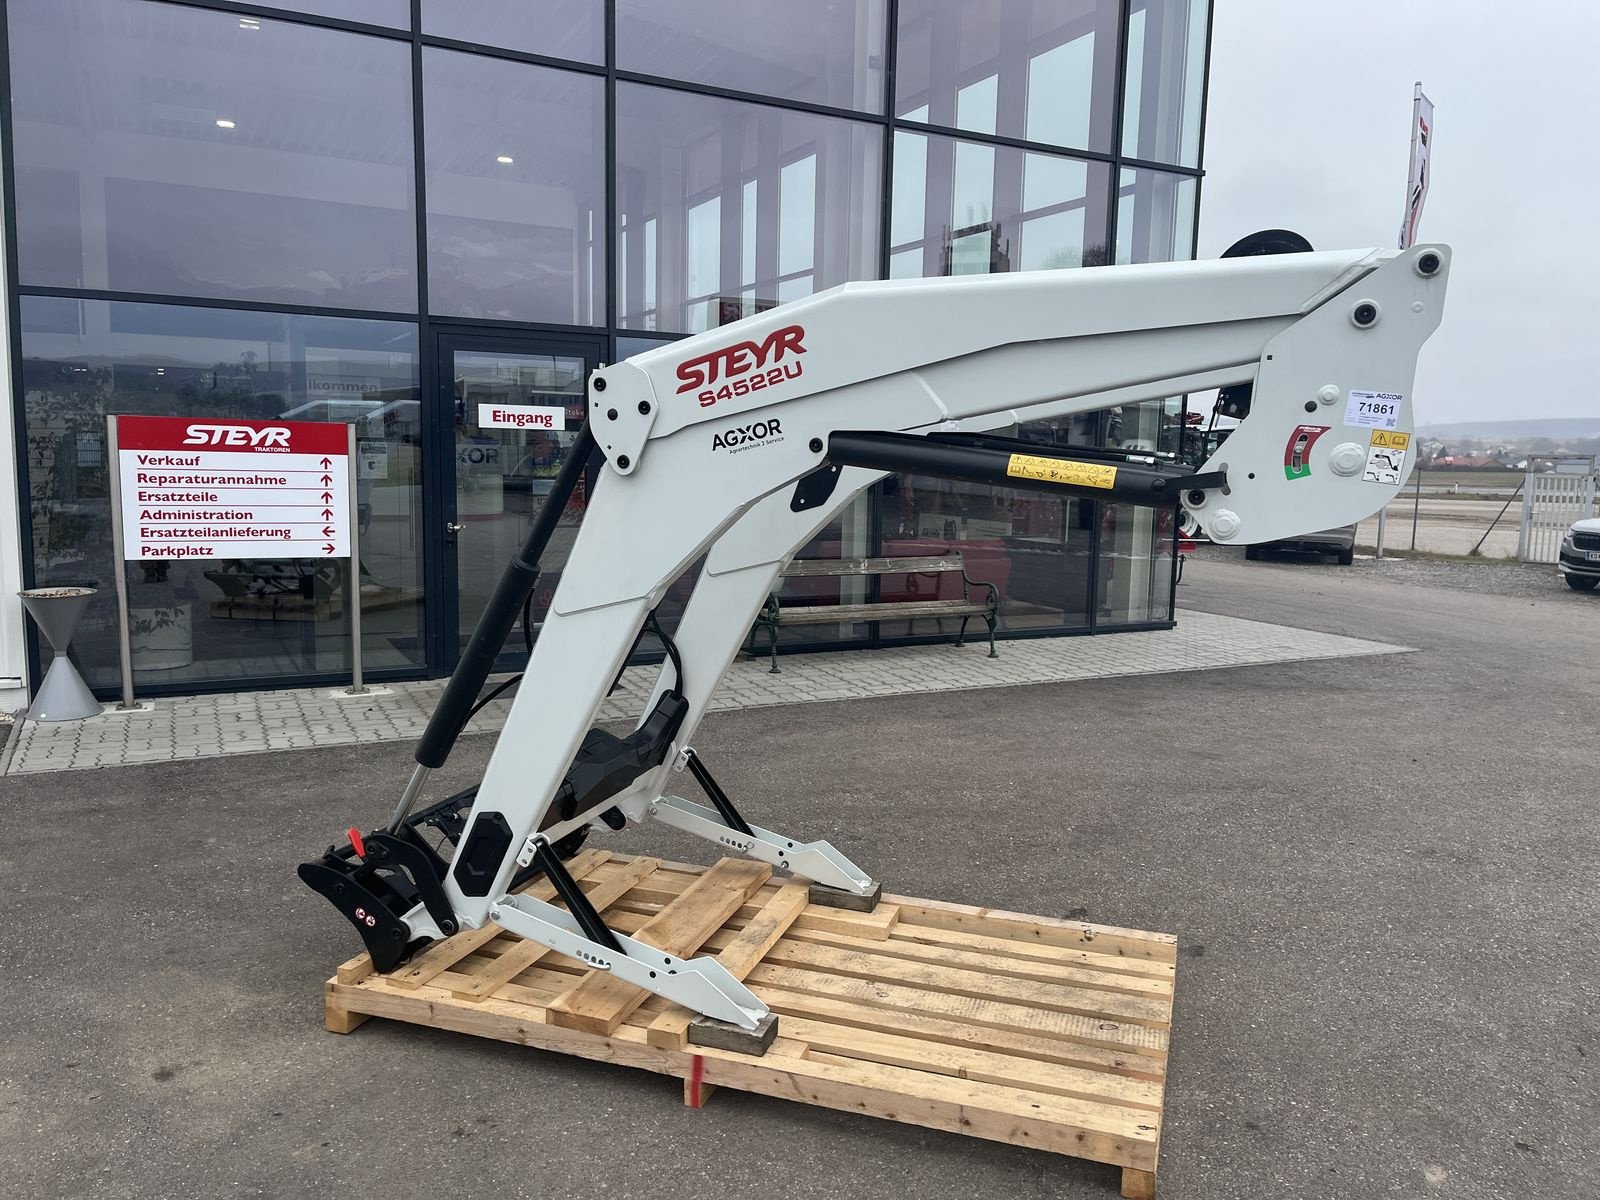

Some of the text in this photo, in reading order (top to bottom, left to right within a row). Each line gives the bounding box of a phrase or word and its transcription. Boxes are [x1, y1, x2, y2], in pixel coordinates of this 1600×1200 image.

[676, 325, 807, 394] STEYR
[308, 379, 377, 392] lkommen
[698, 360, 803, 408] S4522U
[1376, 393, 1403, 401] AGXOR
[1359, 402, 1394, 415] 71861
[492, 410, 553, 427] Eingang
[183, 425, 292, 446] STEYR
[712, 419, 783, 451] AGXOR
[766, 437, 785, 445] Service
[137, 454, 201, 466] Verkauf
[137, 473, 287, 486] Reparaturannahme
[138, 491, 218, 502] Ersatzteile
[140, 509, 253, 520] Administration
[140, 527, 291, 539] Ersatzteilanlieferung
[141, 546, 214, 558] Parkplatz
